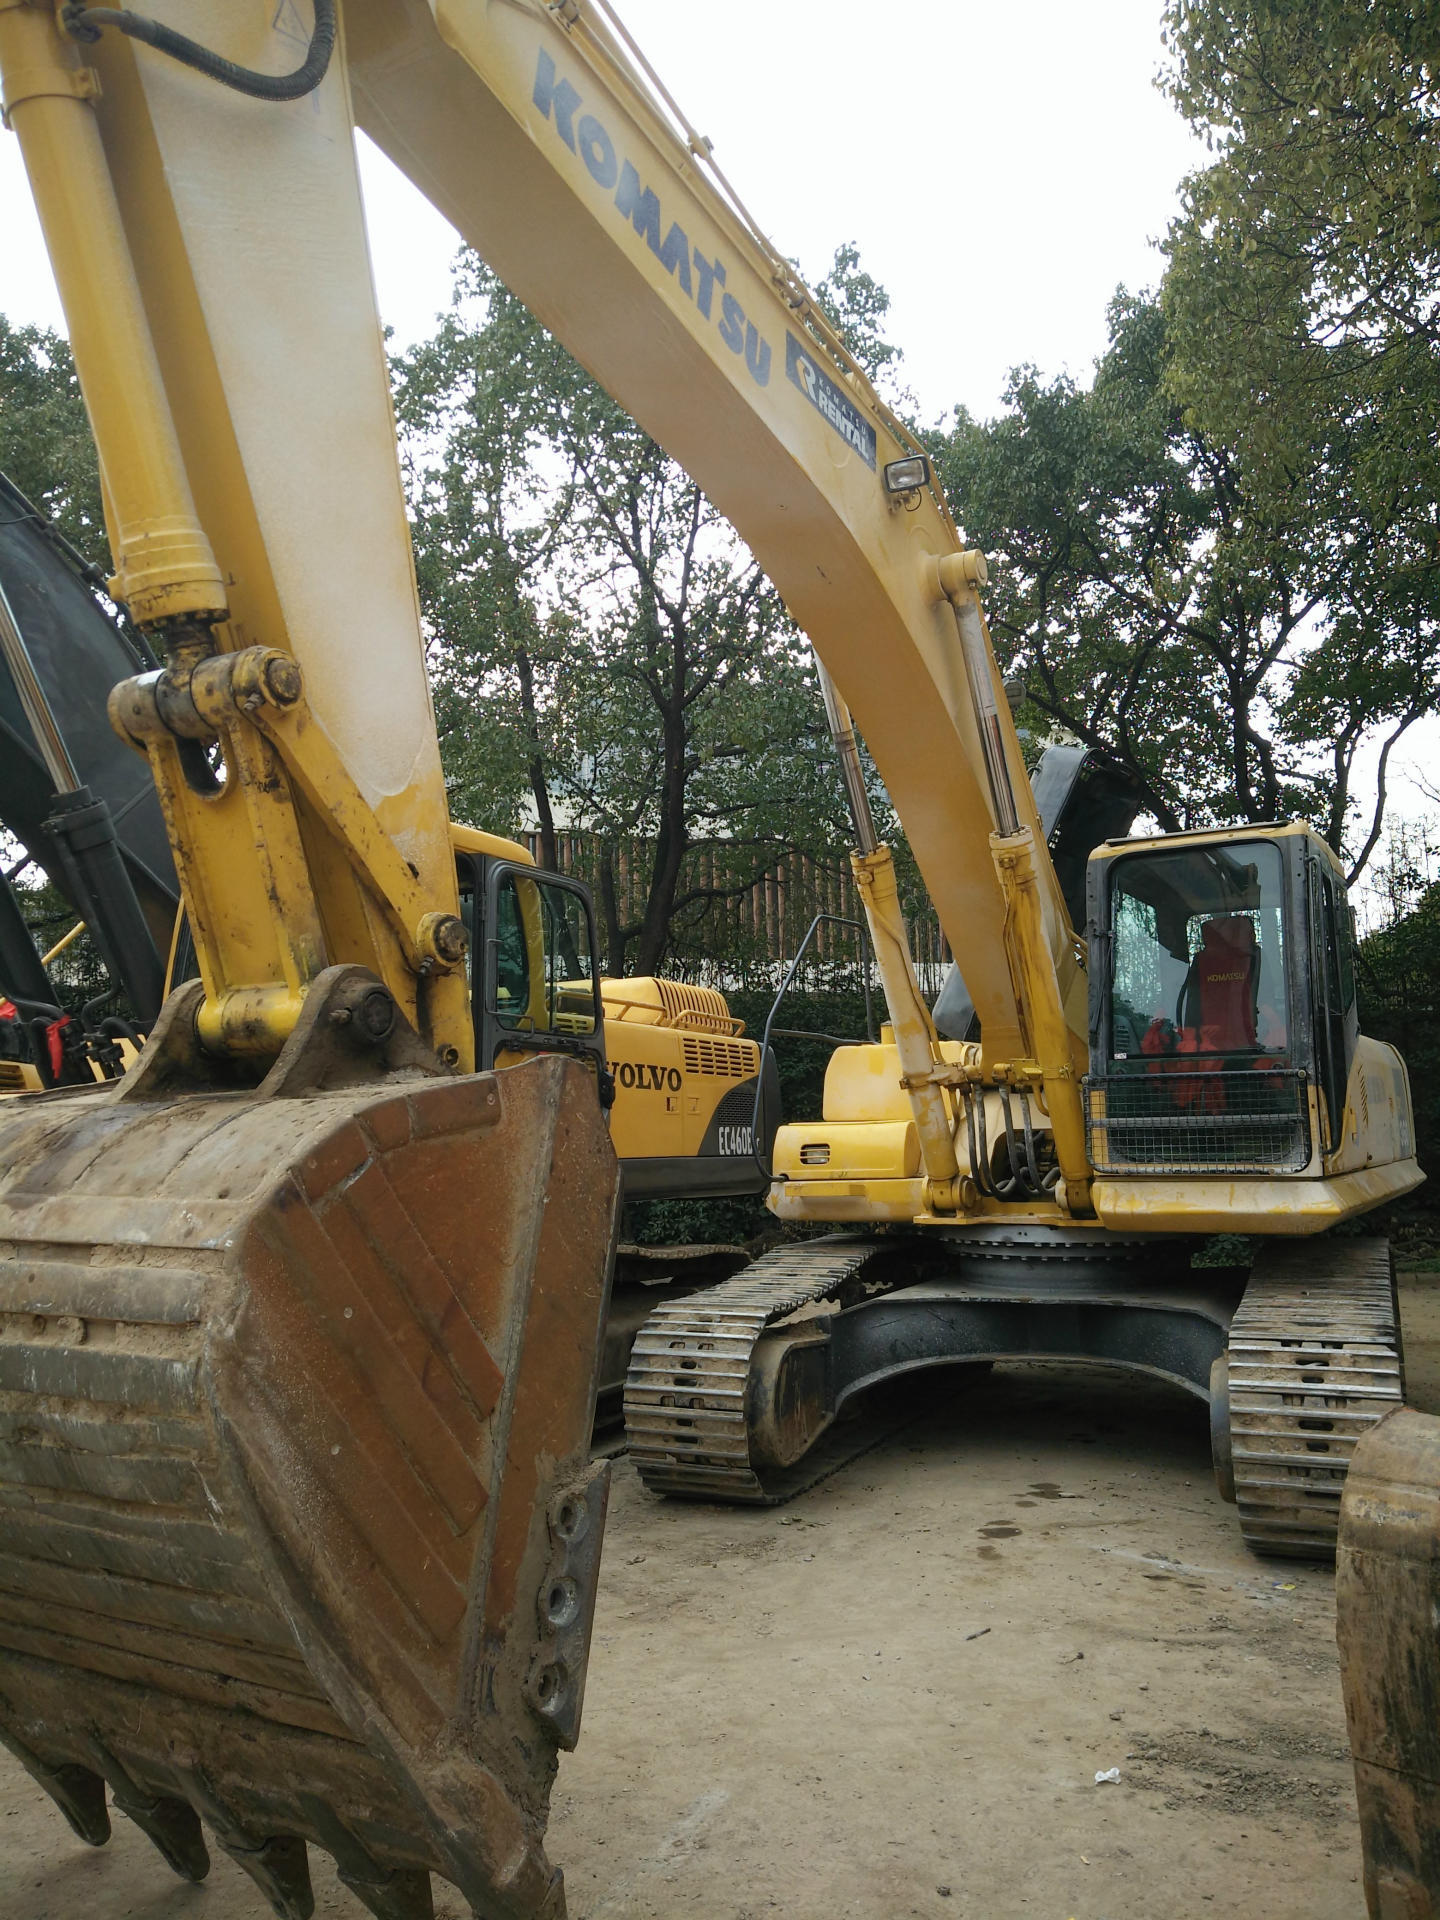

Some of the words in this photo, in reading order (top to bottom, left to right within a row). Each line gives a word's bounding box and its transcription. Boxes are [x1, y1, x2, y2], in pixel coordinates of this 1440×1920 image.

[532, 45, 771, 388] KOMATSU
[818, 389, 870, 460] RENTAL
[1207, 970, 1245, 983] KOMATSU
